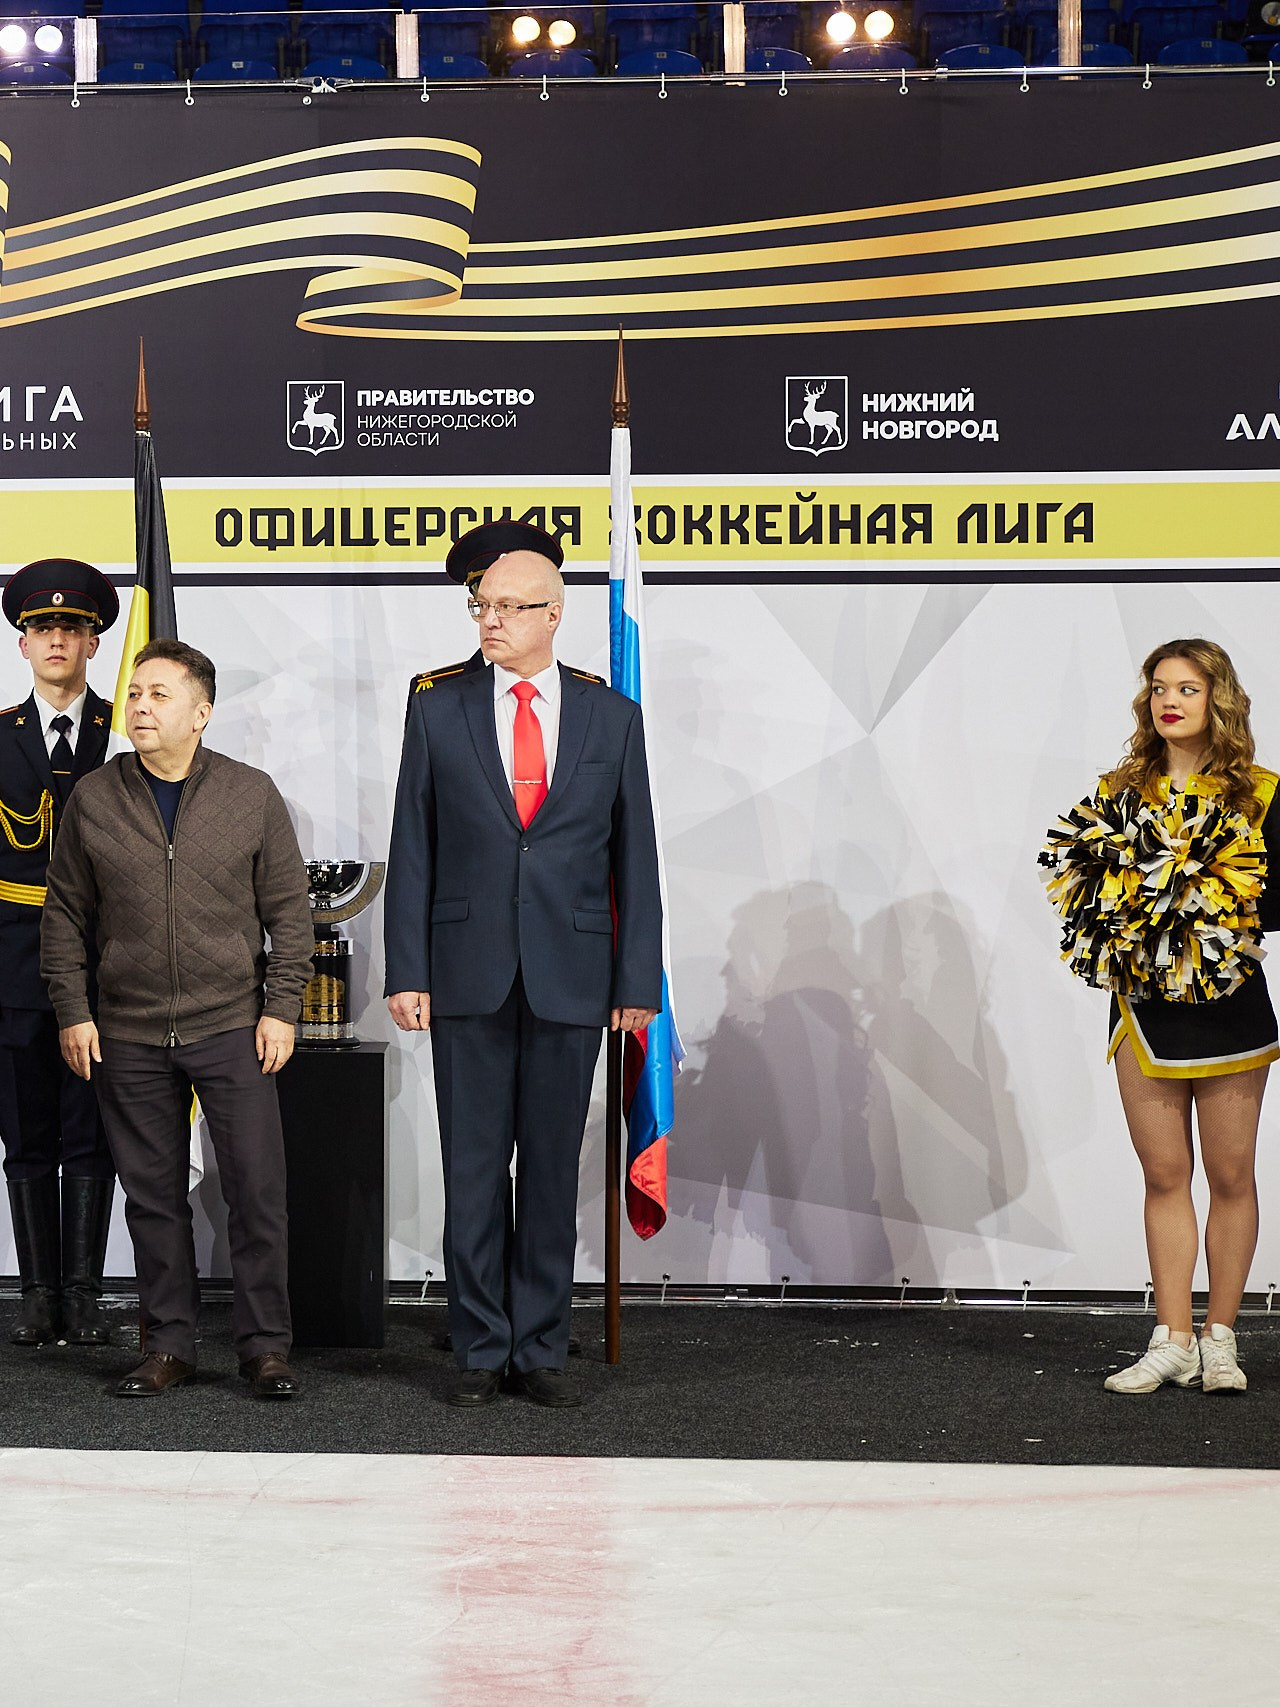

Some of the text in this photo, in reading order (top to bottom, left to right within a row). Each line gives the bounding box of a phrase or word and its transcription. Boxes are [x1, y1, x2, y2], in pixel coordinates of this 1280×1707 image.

[357, 388, 535, 407] ПРАВИТЕЛЬСТВО
[862, 387, 975, 412] НИЖНИЙ
[357, 411, 518, 430] НИЖЕГОРОДСКОЙ
[862, 419, 999, 442] НОВГОРОД
[357, 432, 440, 447] ОБЛАСТИ
[608, 491, 933, 546] ОККЕЙНАЯ
[957, 502, 1095, 545] ЛИГА
